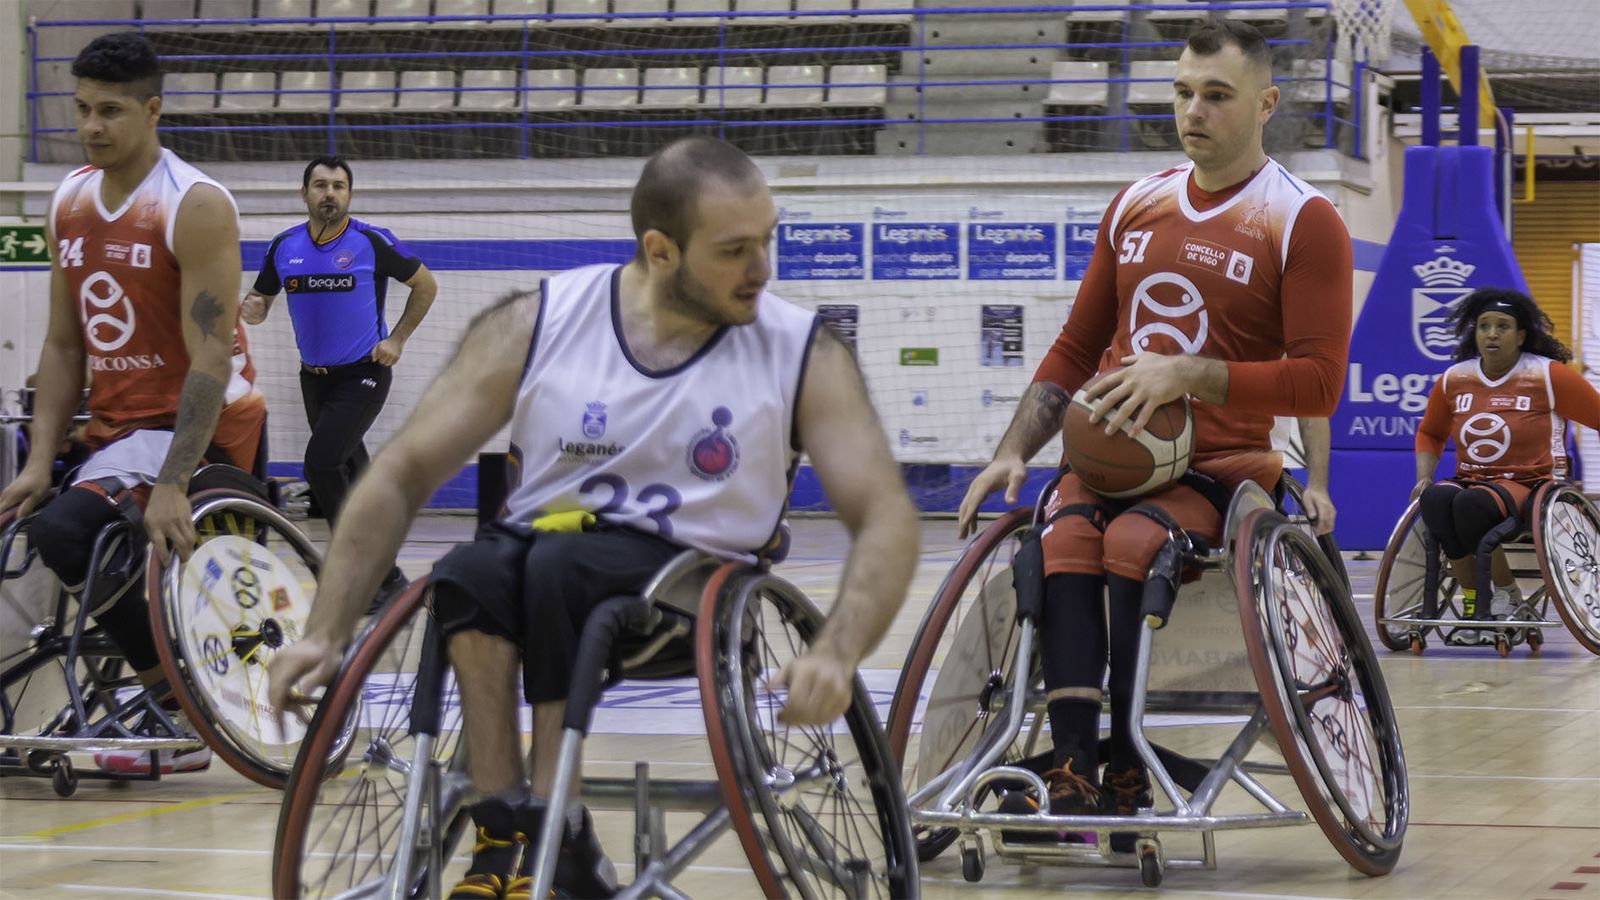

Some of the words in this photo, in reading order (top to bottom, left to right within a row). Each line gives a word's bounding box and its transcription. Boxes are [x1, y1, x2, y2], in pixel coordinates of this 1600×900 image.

[785, 225, 853, 244] Leganés
[880, 225, 949, 244] Leganés
[975, 225, 1045, 244] Leganés
[59, 237, 84, 268] 24
[1119, 231, 1154, 264] 51
[1185, 243, 1225, 260] CONCELLO
[814, 252, 857, 264] deporte
[909, 252, 953, 264] deporte
[1005, 252, 1049, 264] deporte
[1186, 251, 1198, 262] DE
[1199, 253, 1218, 267] VIGO
[308, 275, 353, 290] bequal
[1350, 362, 1441, 412] Leg
[1455, 392, 1474, 413] 10
[579, 473, 683, 538] 23
